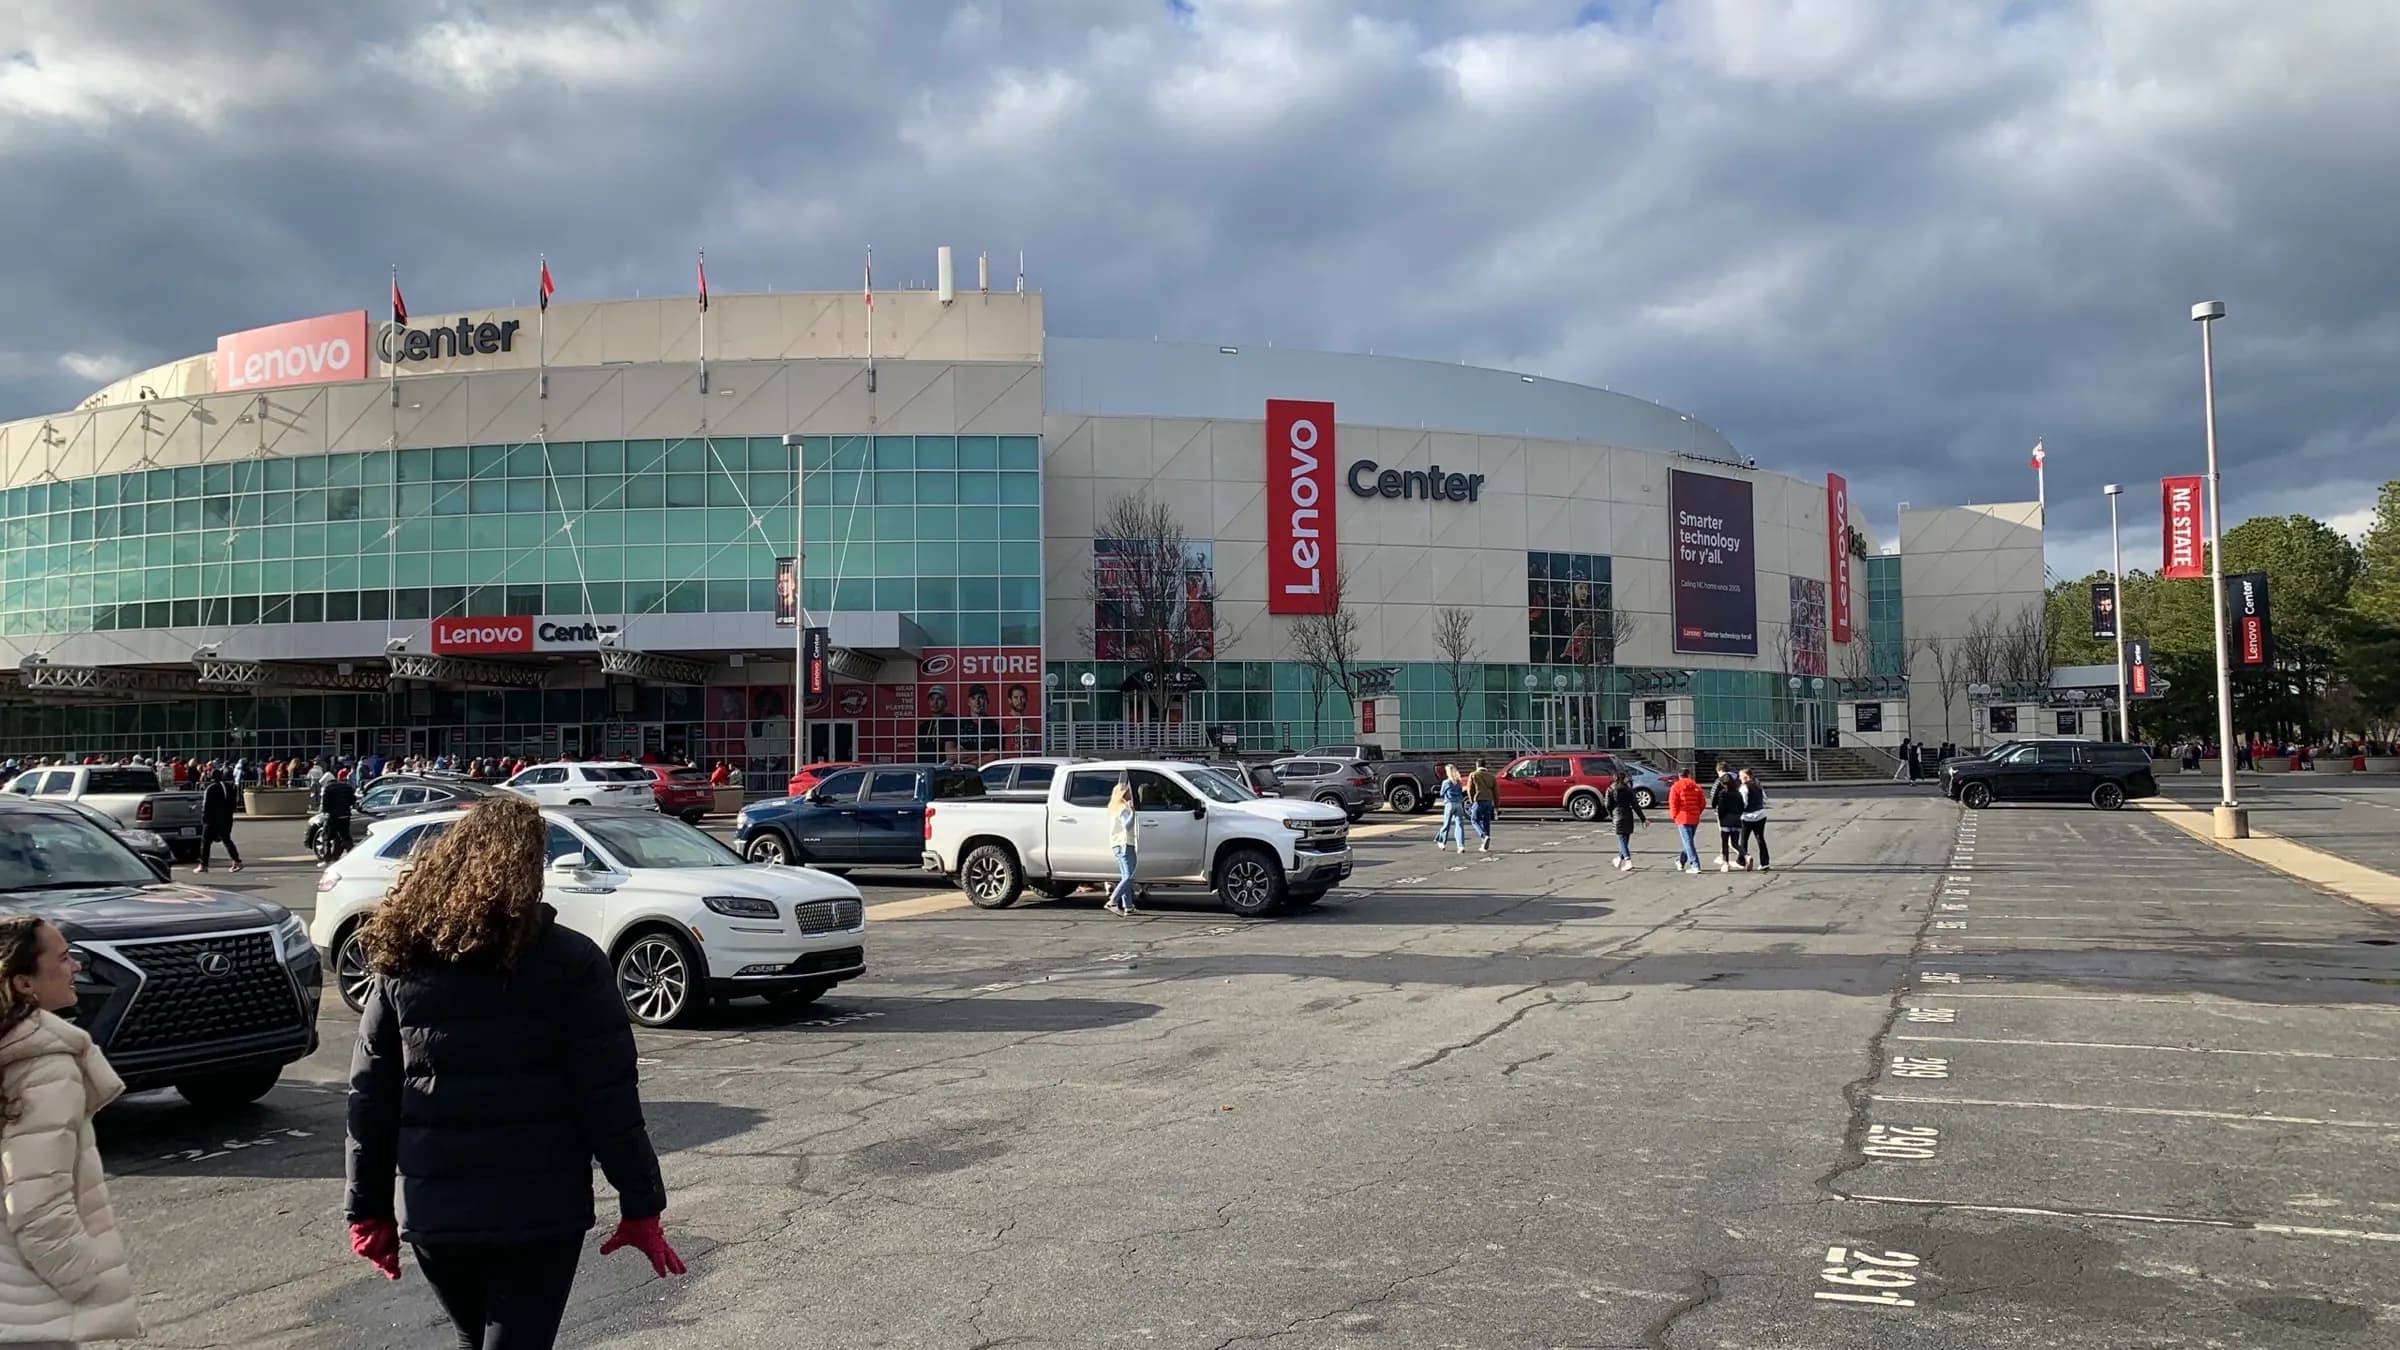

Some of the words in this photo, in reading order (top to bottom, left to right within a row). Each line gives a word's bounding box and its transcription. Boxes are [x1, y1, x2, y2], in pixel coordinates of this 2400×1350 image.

[228, 338, 349, 387] Lenovo
[376, 317, 519, 364] Center
[1347, 459, 1485, 502] Center
[1285, 419, 1320, 594] Lenovo
[2173, 488, 2191, 512] NC
[1680, 510, 1723, 530] Smarter
[1680, 529, 1740, 552] technology
[1680, 545, 1696, 561] for
[1699, 547, 1723, 565] y'all.
[2173, 516, 2192, 567] STATE
[1837, 490, 1848, 627] Lenovo
[2243, 580, 2254, 615] Center
[440, 625, 523, 644] Lenovo
[2247, 621, 2258, 660] Lenovo
[963, 655, 1038, 674] STORE
[2134, 644, 2142, 665] Center
[1906, 1007, 1956, 1023] 288
[1891, 1056, 1948, 1078] 289
[1862, 1124, 1939, 1159] 290
[1814, 1247, 1920, 1307] 291
